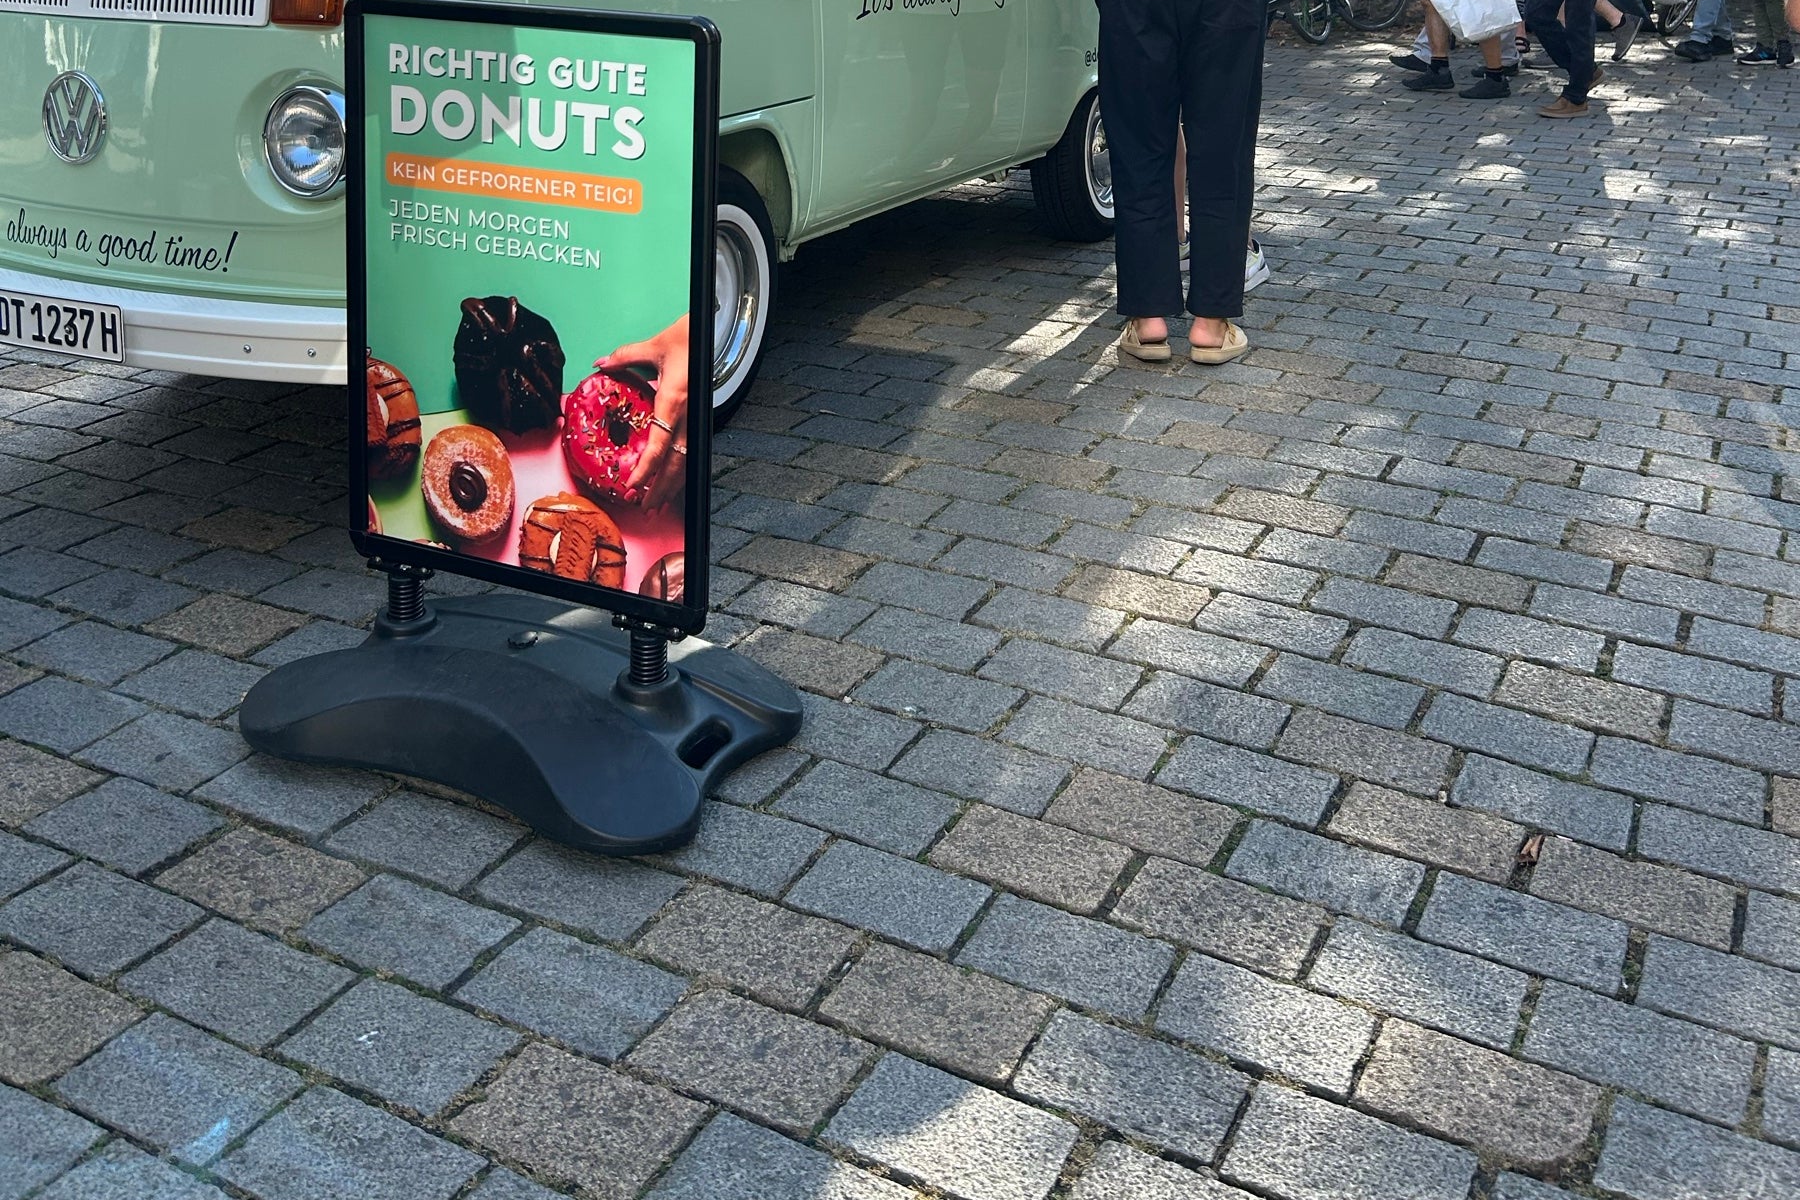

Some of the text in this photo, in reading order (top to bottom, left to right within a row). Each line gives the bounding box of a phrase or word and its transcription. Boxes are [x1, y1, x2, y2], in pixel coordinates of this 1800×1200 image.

[389, 43, 647, 97] RICHTIG GUTE
[391, 84, 646, 161] DONUTS
[393, 161, 634, 205] KEIN GEFRORENER TEIG!
[7, 207, 239, 272] always a good time!
[389, 199, 570, 240] JEDEN MORGEN
[390, 222, 601, 270] FRISCH GEBACKEN
